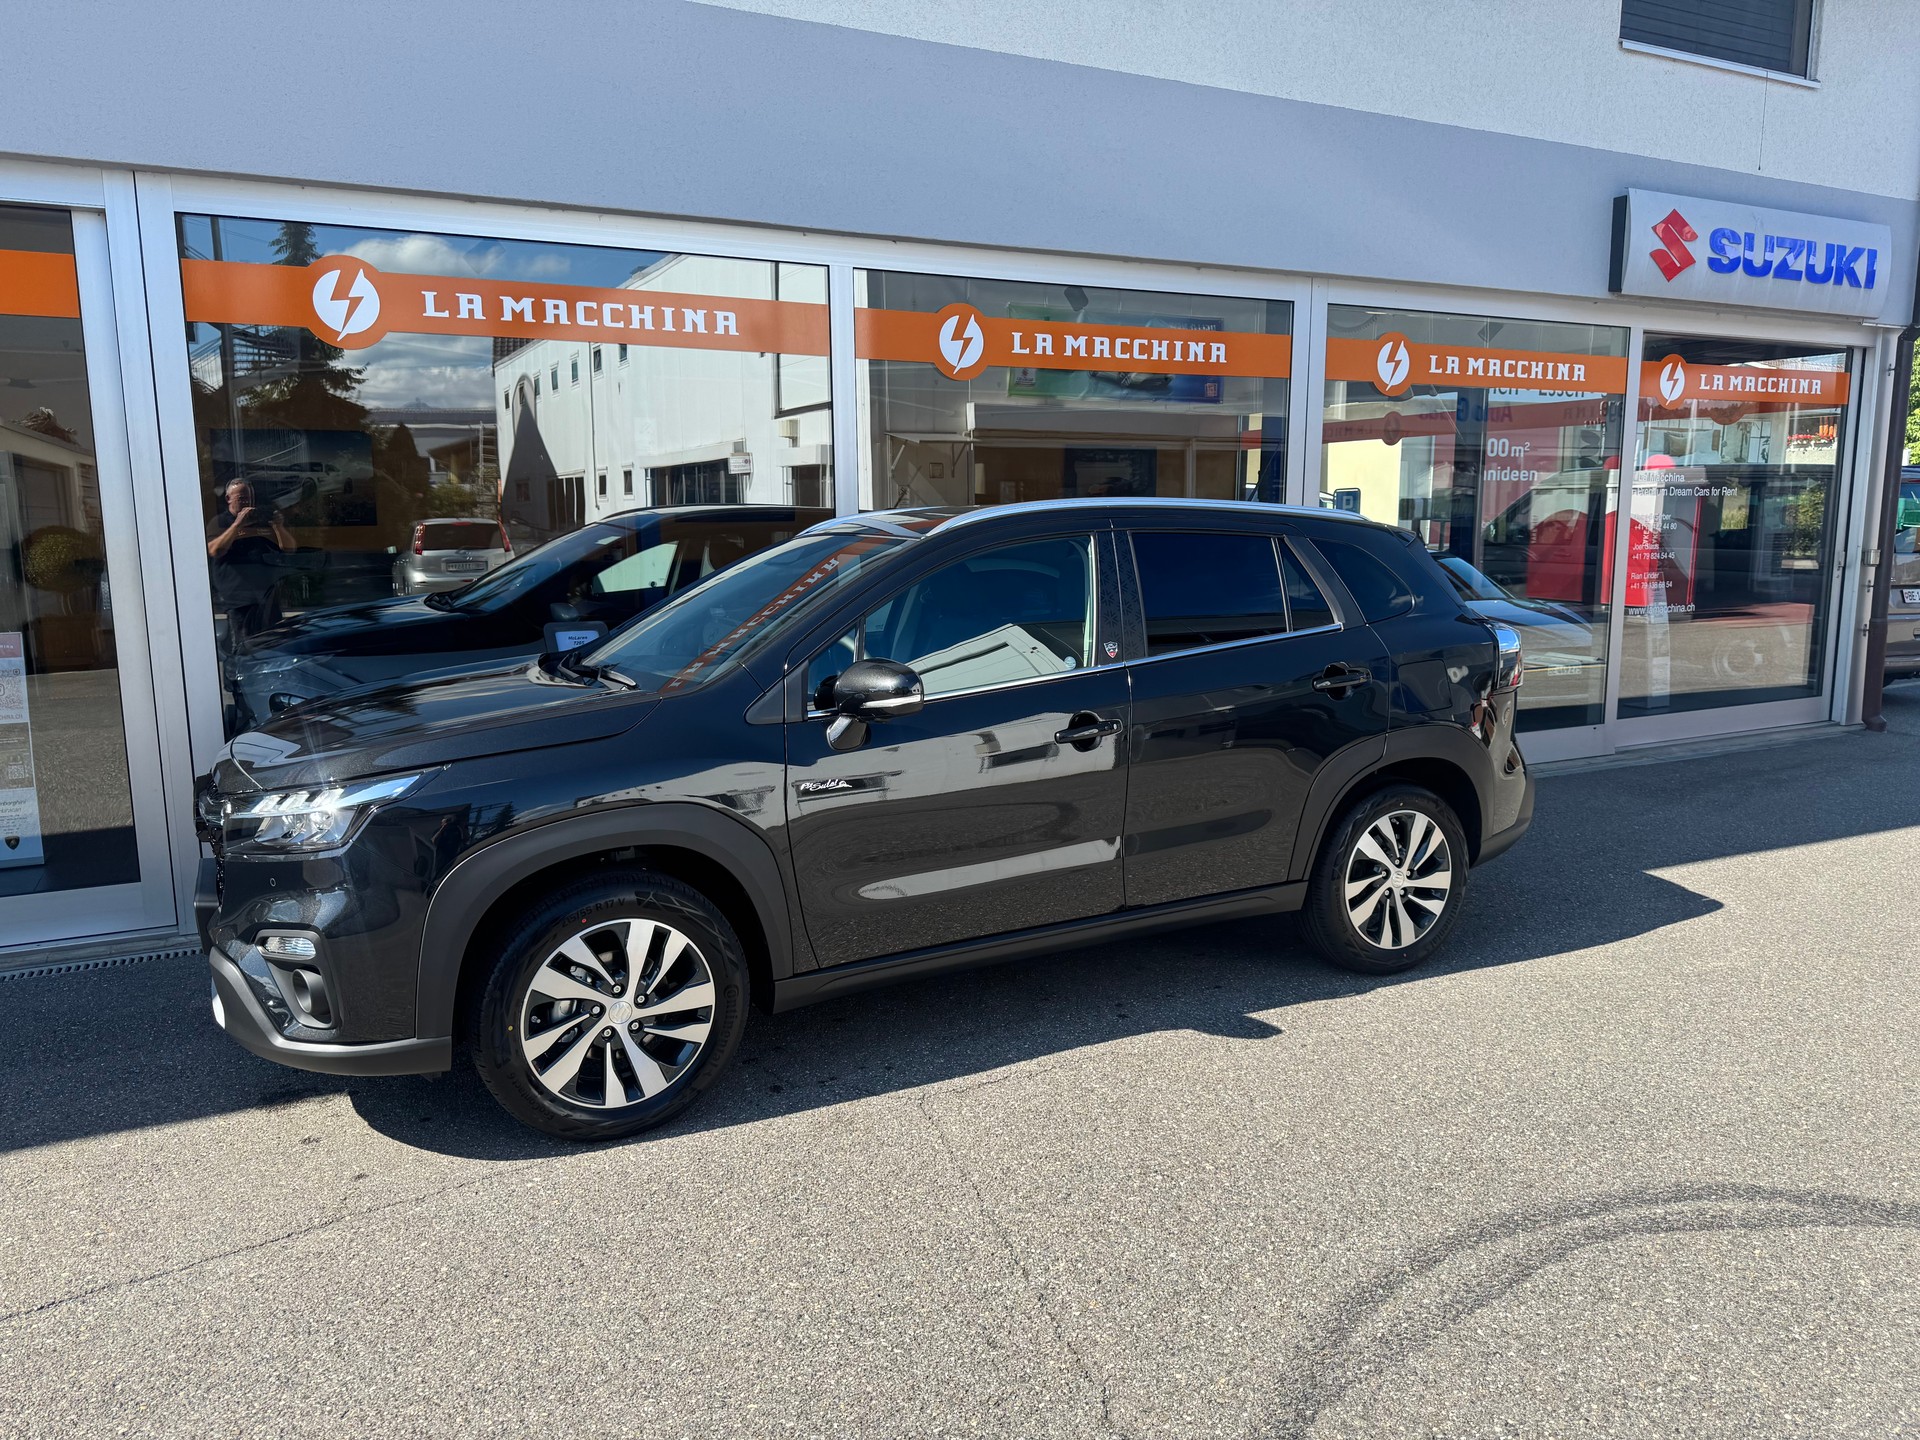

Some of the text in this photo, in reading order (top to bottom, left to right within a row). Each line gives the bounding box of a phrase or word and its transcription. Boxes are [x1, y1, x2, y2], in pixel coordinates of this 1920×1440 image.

[1707, 227, 1878, 289] SUZUKI
[421, 290, 739, 335] LA MACCHINA
[1011, 332, 1227, 363] LA MACCHINA
[1429, 355, 1586, 381] LA MACCHINA
[1699, 373, 1822, 394] LA MACCHINA
[1650, 471, 1685, 482] Macchina
[1669, 486, 1693, 496] Dream
[1694, 486, 1710, 496] Cars
[1711, 486, 1720, 496] for
[1721, 486, 1738, 496] Rent
